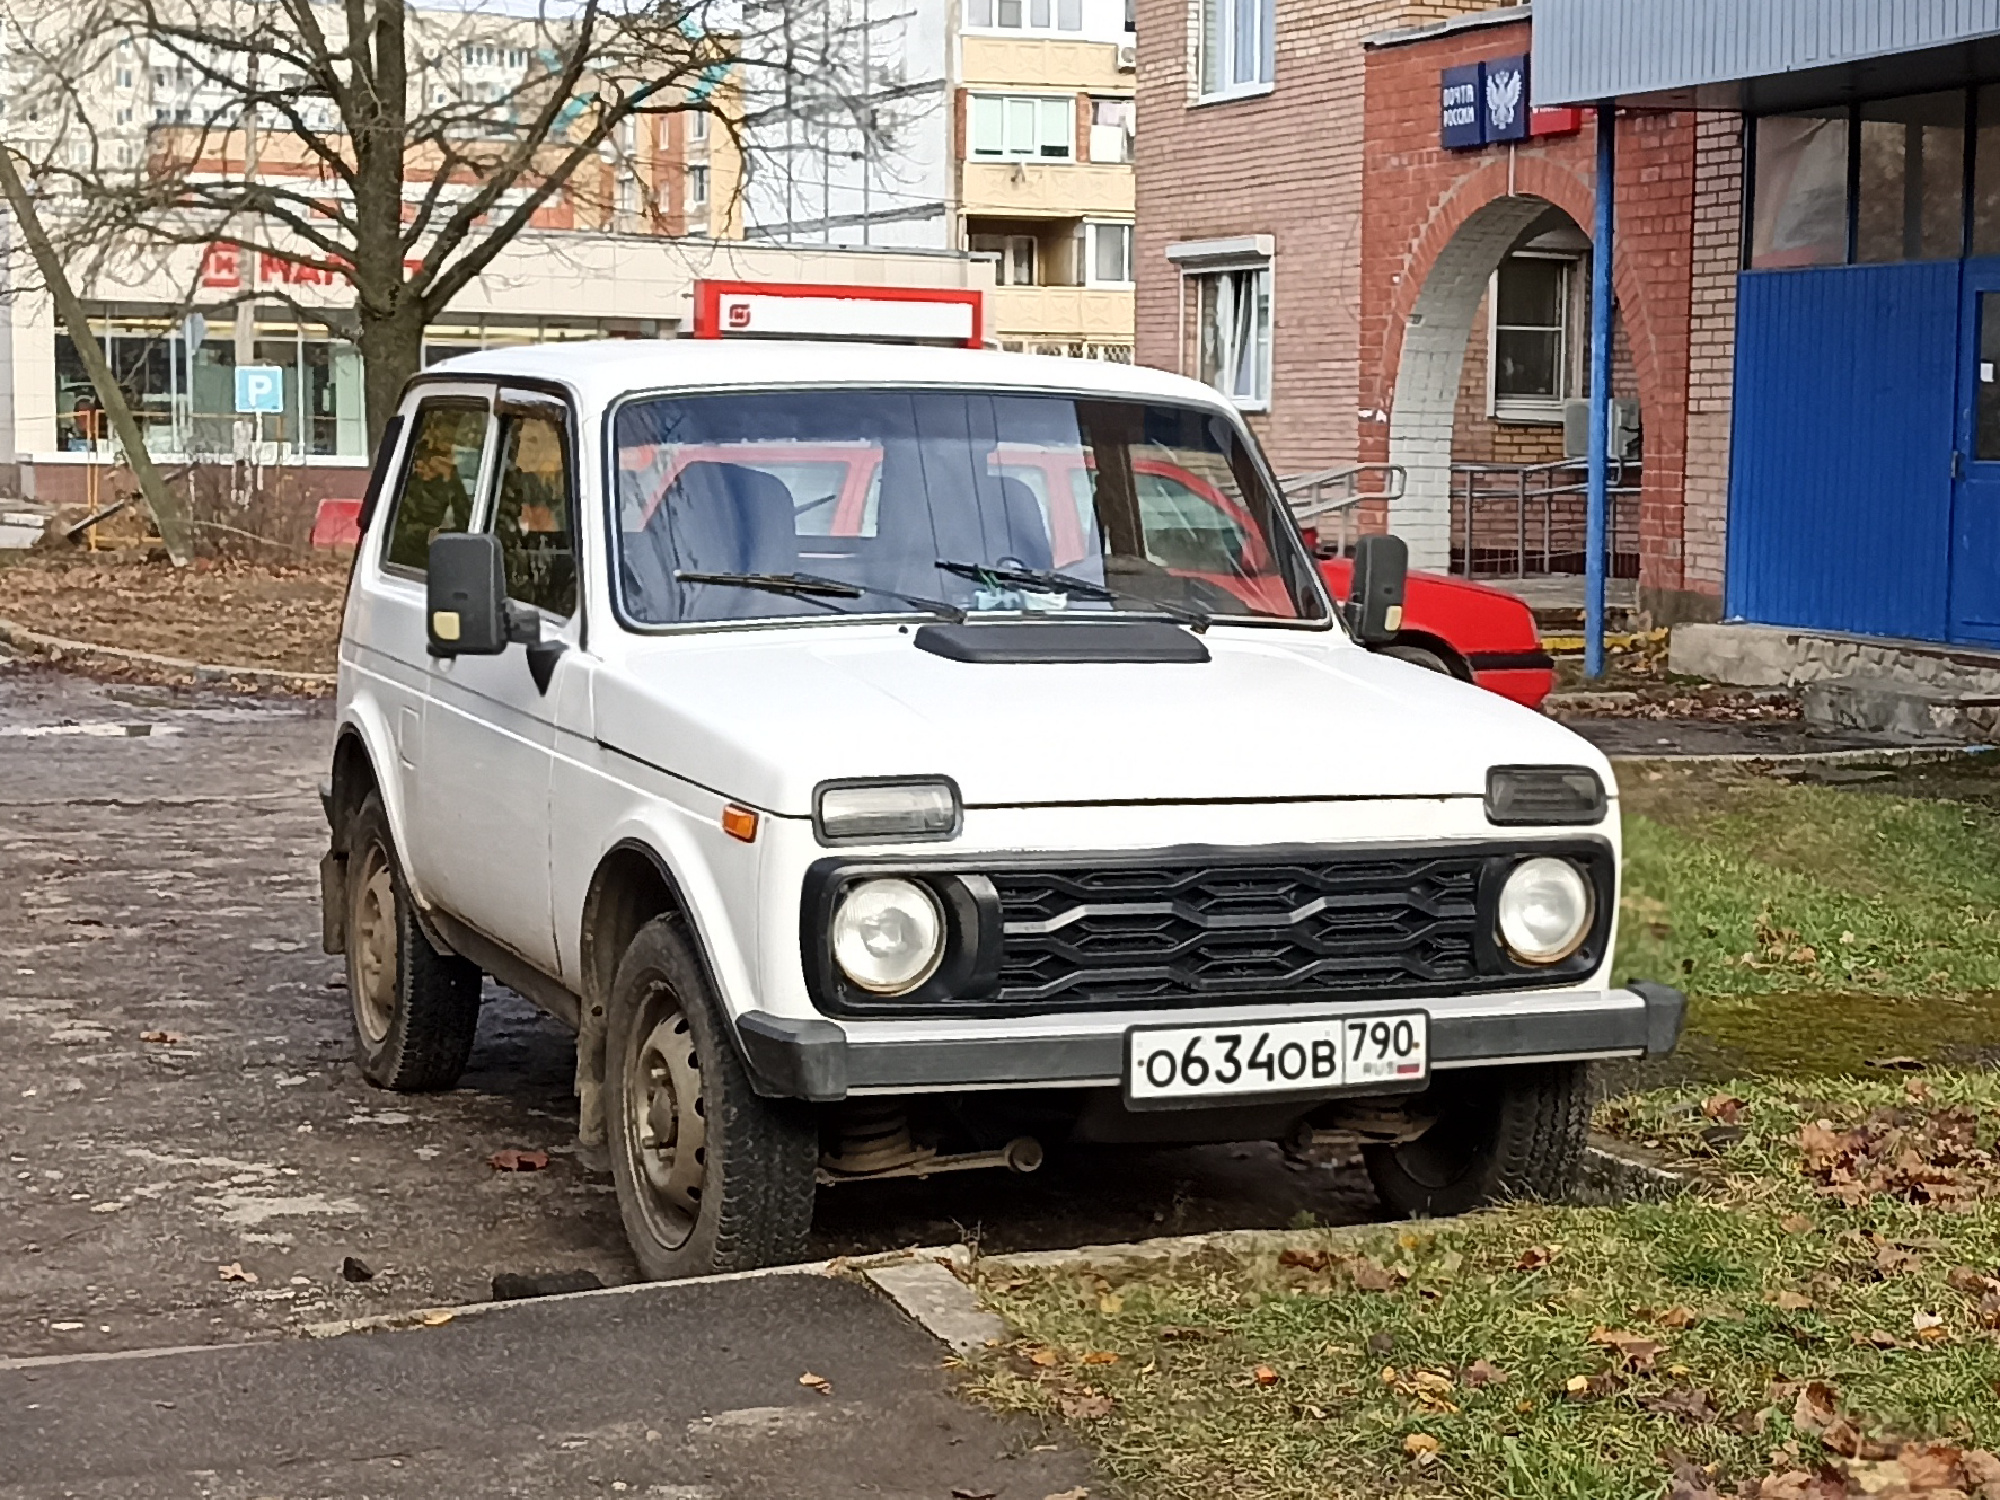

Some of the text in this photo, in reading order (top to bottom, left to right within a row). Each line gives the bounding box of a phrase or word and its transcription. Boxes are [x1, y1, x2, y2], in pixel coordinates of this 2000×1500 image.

[247, 374, 273, 407] P
[1146, 1020, 1413, 1088] О634ОВ 790
